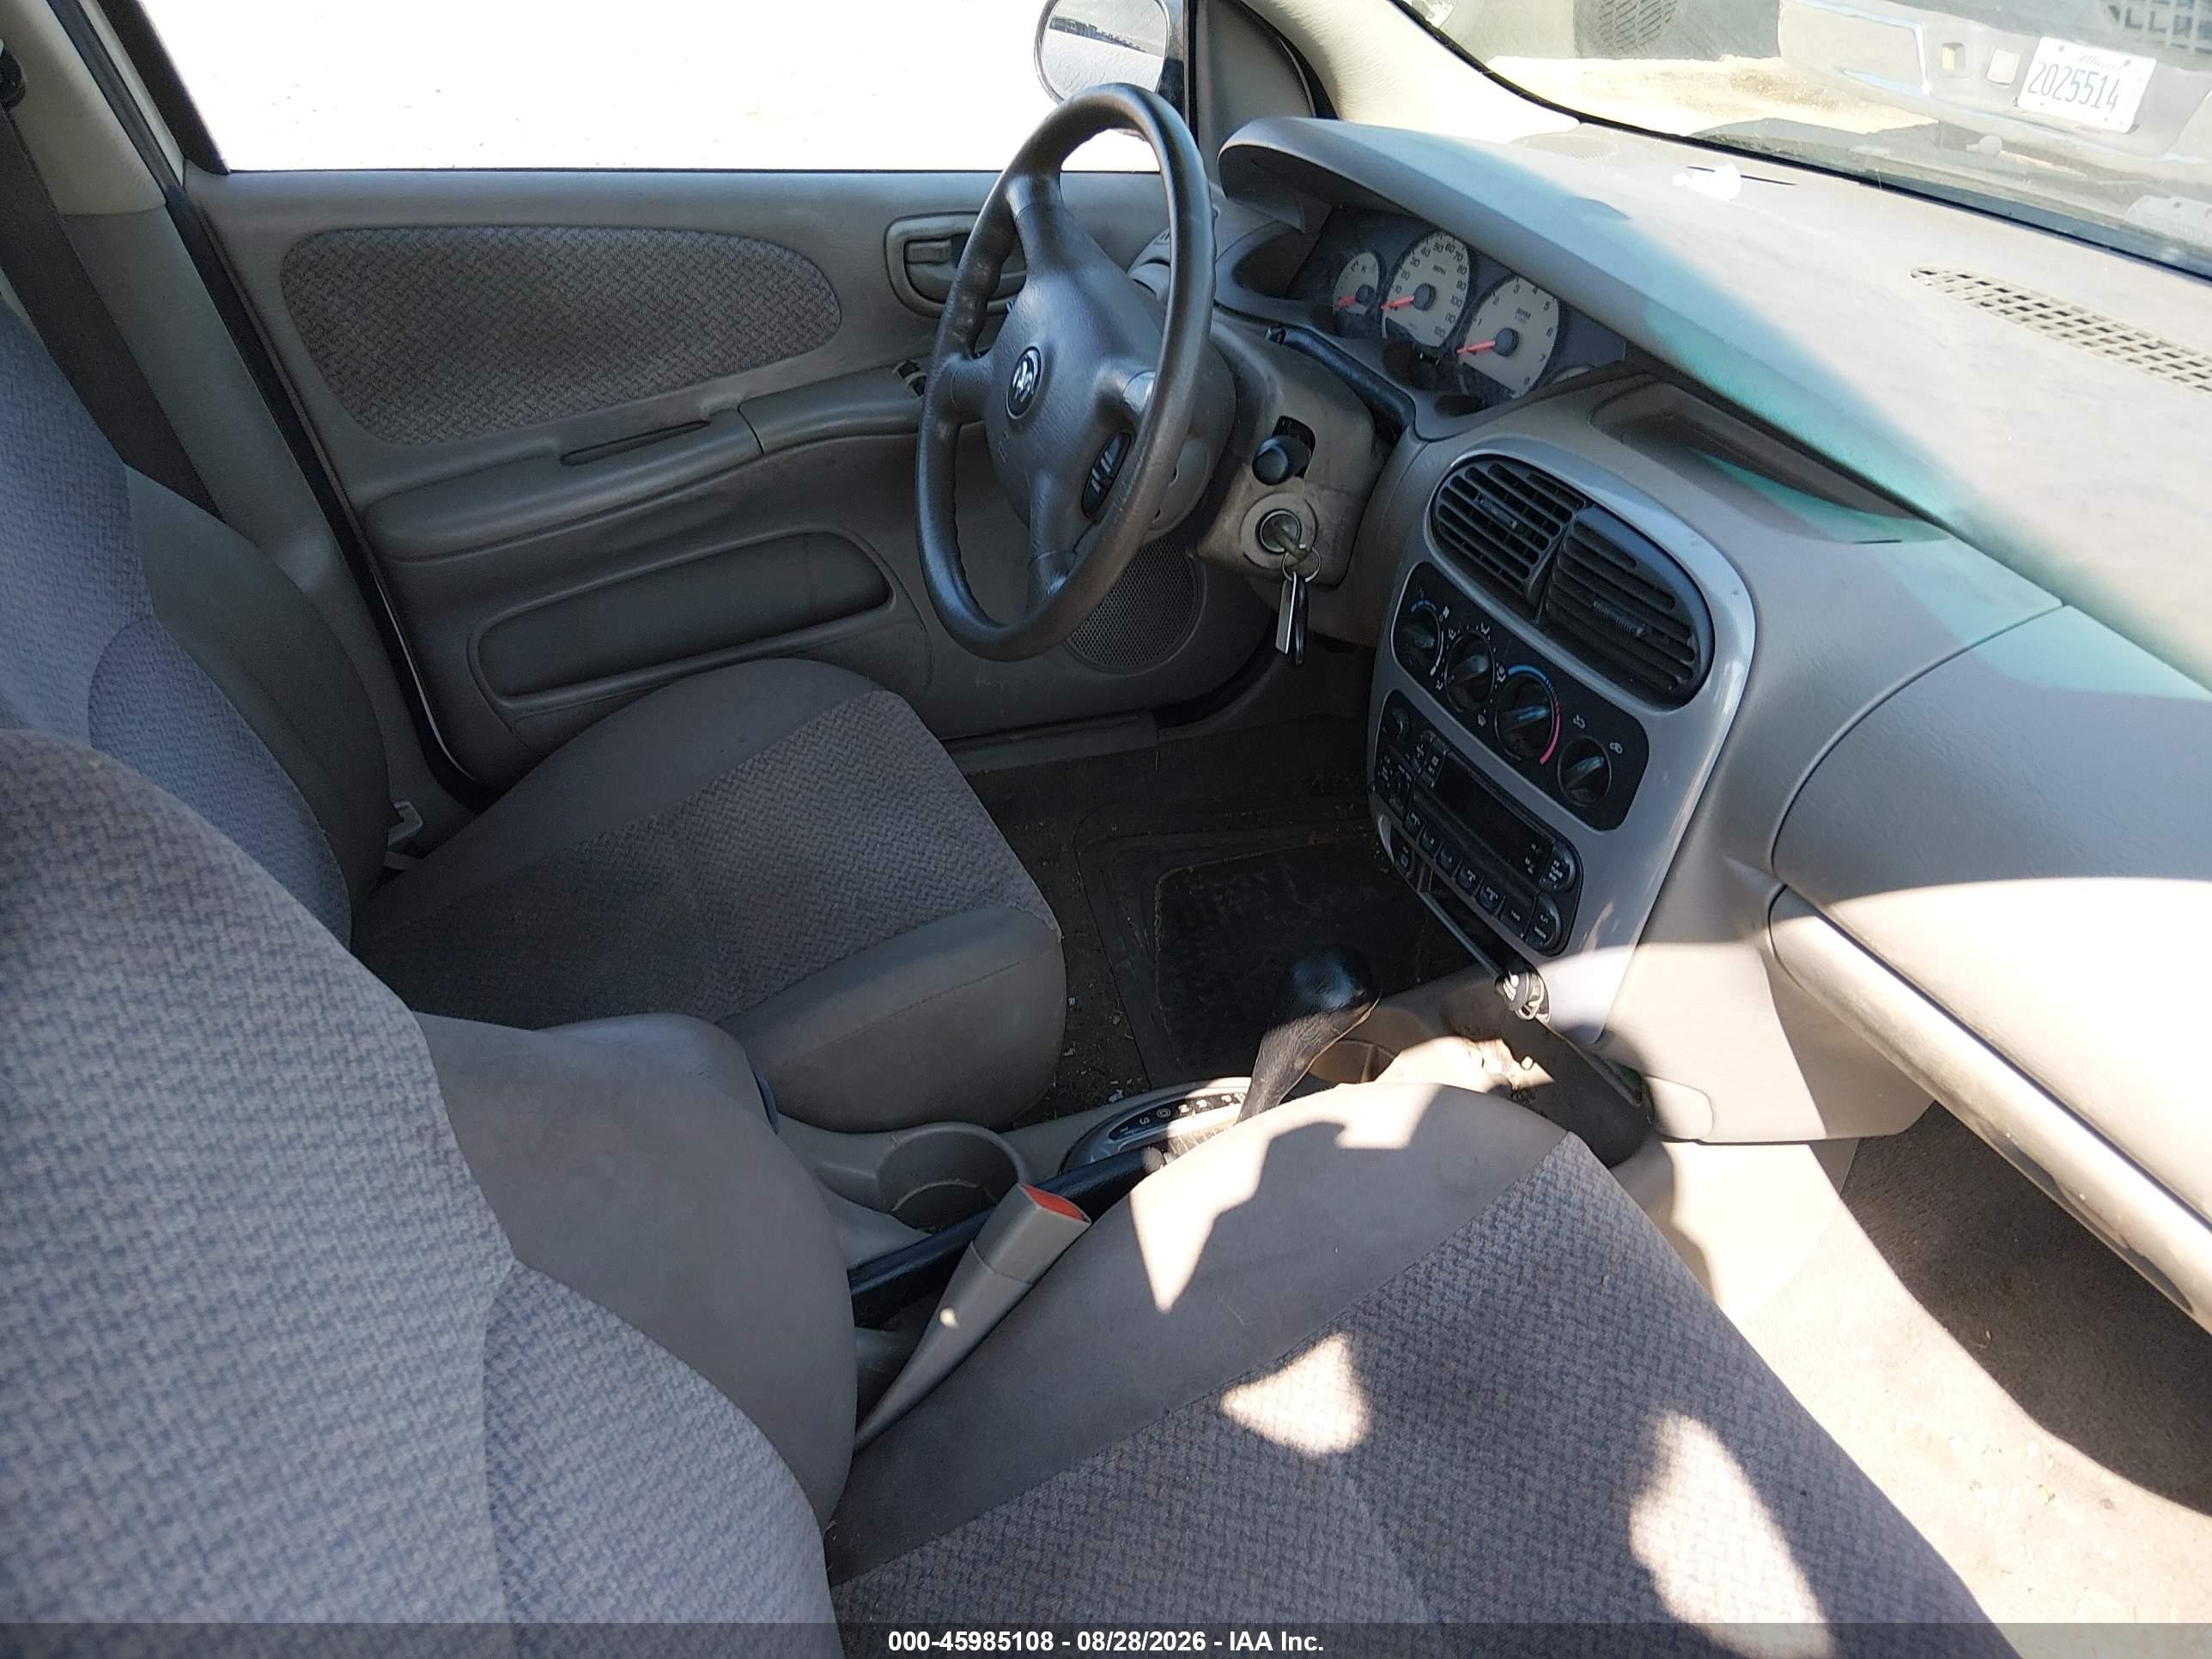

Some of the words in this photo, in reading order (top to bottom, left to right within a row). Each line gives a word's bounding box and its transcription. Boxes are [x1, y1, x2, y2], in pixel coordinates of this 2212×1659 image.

[2027, 62, 2121, 112] 2025514
[1420, 246, 1431, 258] 40
[1445, 242, 1455, 253] 60
[1453, 252, 1463, 262] 70
[1394, 285, 1402, 295] 10
[1456, 280, 1467, 292] 90
[1449, 295, 1463, 308] 100
[1516, 307, 1532, 321] RPM
